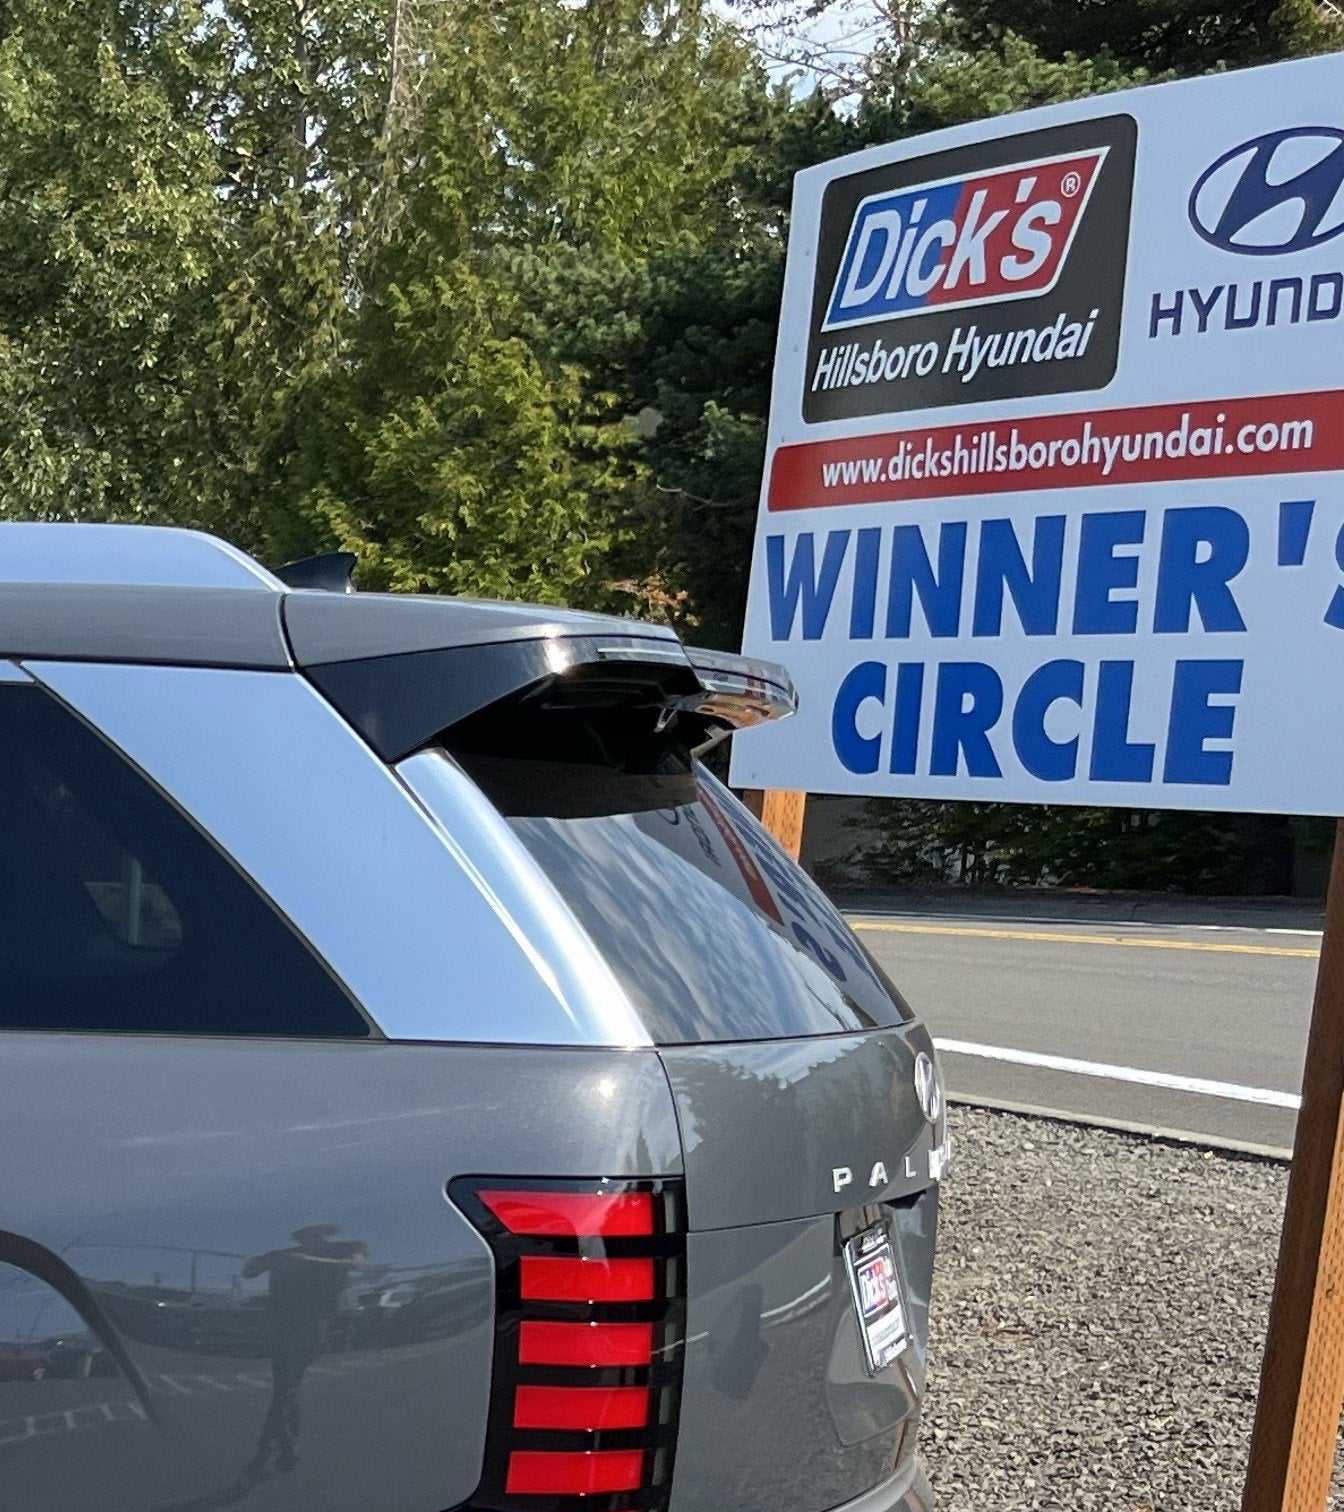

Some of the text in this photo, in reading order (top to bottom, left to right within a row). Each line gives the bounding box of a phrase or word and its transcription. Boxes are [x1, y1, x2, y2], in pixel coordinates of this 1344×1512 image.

[811, 308, 1100, 393] Hillsboro Hyundai
[822, 413, 1313, 487] www.dickshillsborohyundai.com
[766, 500, 1344, 641] WINNER'
[831, 658, 1244, 785] CIRCLE
